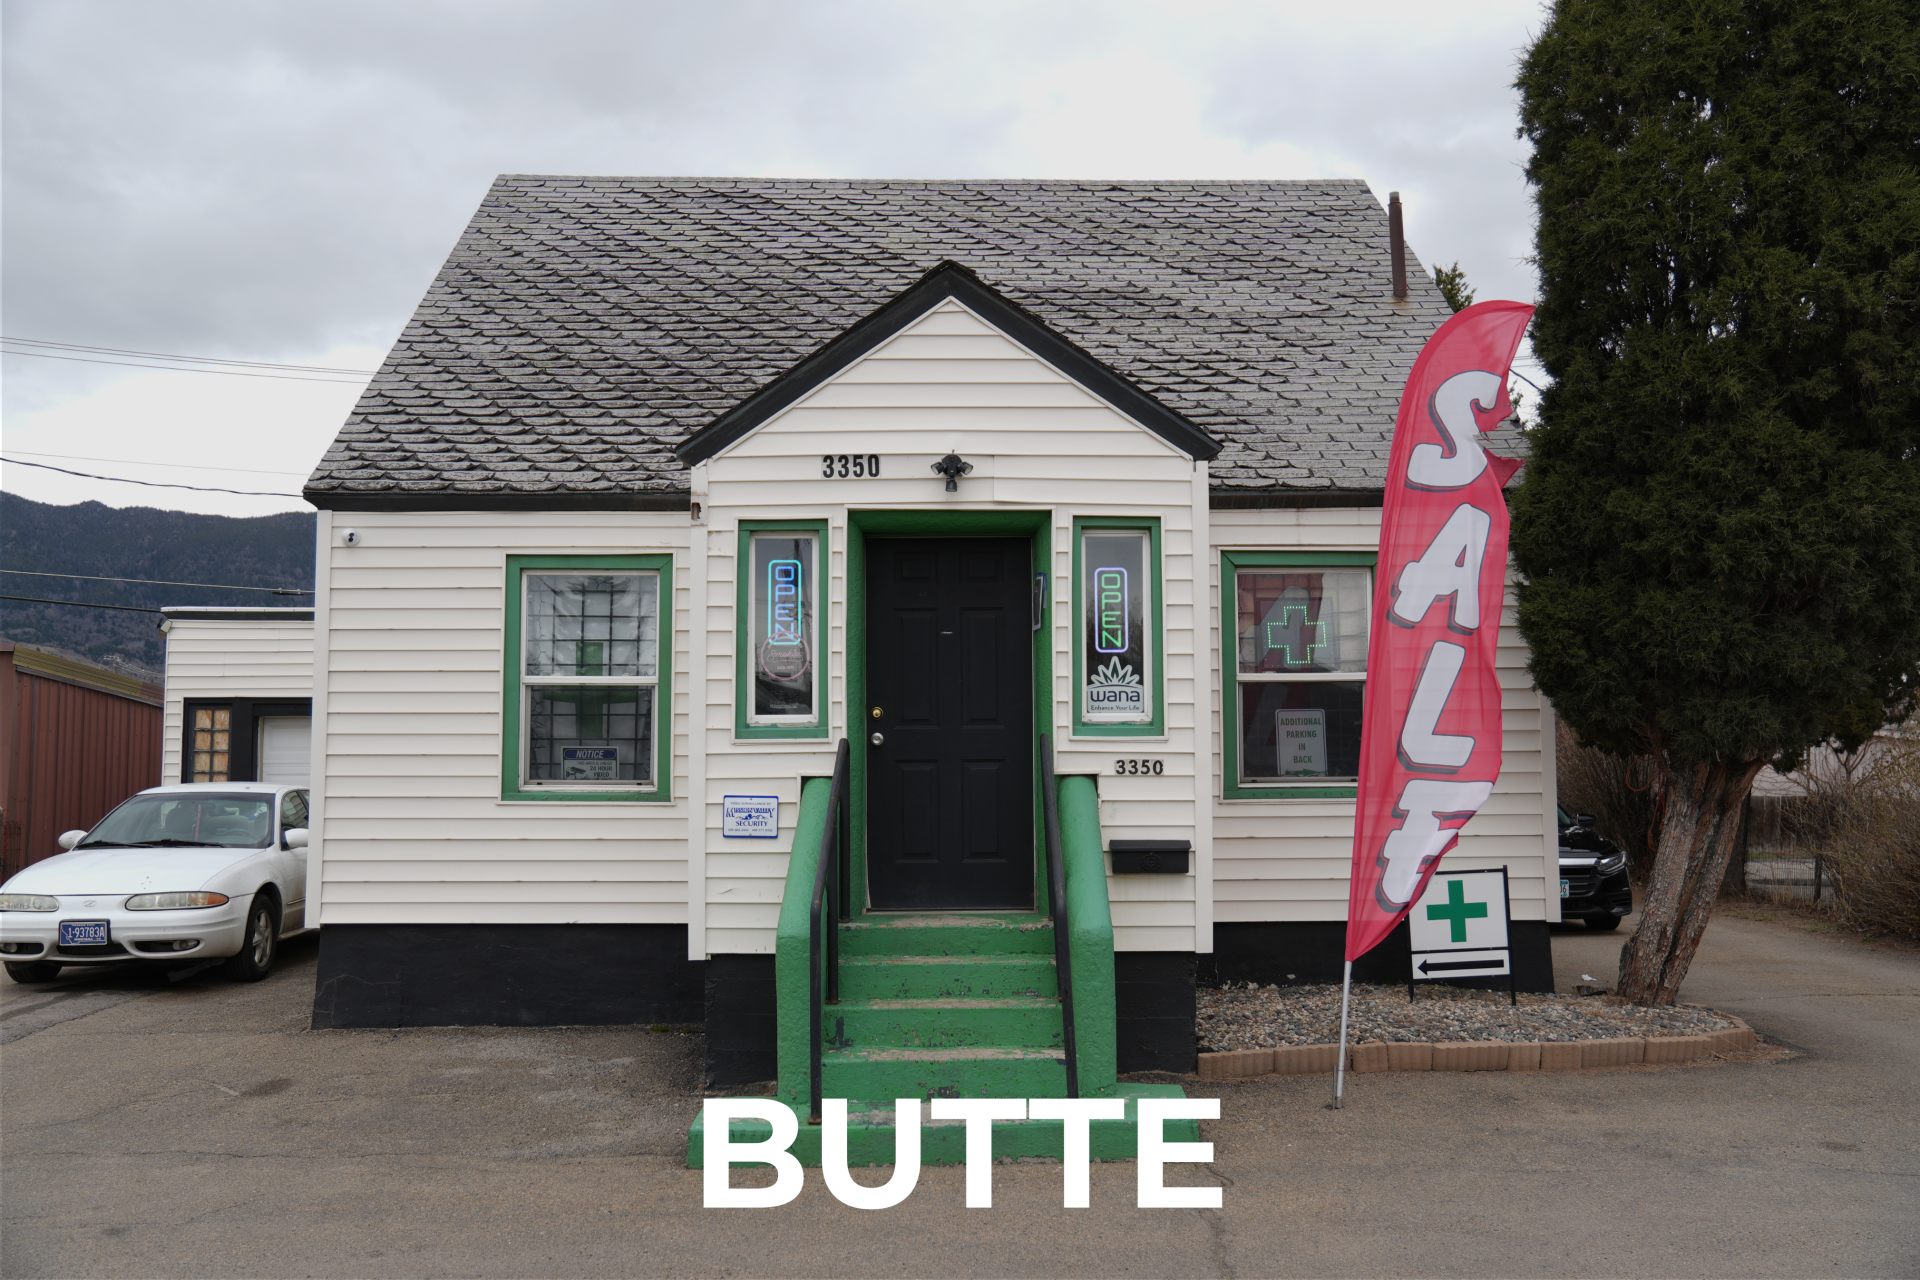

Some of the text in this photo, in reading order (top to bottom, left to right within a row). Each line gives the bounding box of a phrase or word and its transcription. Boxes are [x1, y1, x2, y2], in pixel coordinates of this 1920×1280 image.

[822, 454, 880, 478] 3350
[775, 565, 795, 640] OPEN
[1101, 574, 1122, 648] OPEN
[1377, 369, 1503, 910] SALE
[1090, 690, 1140, 702] wana
[1281, 718, 1322, 726] ADDITIONAL
[1286, 730, 1317, 738] PARKING
[1298, 743, 1306, 751] IN
[576, 750, 604, 759] NOTICE
[1115, 760, 1164, 775] 3350
